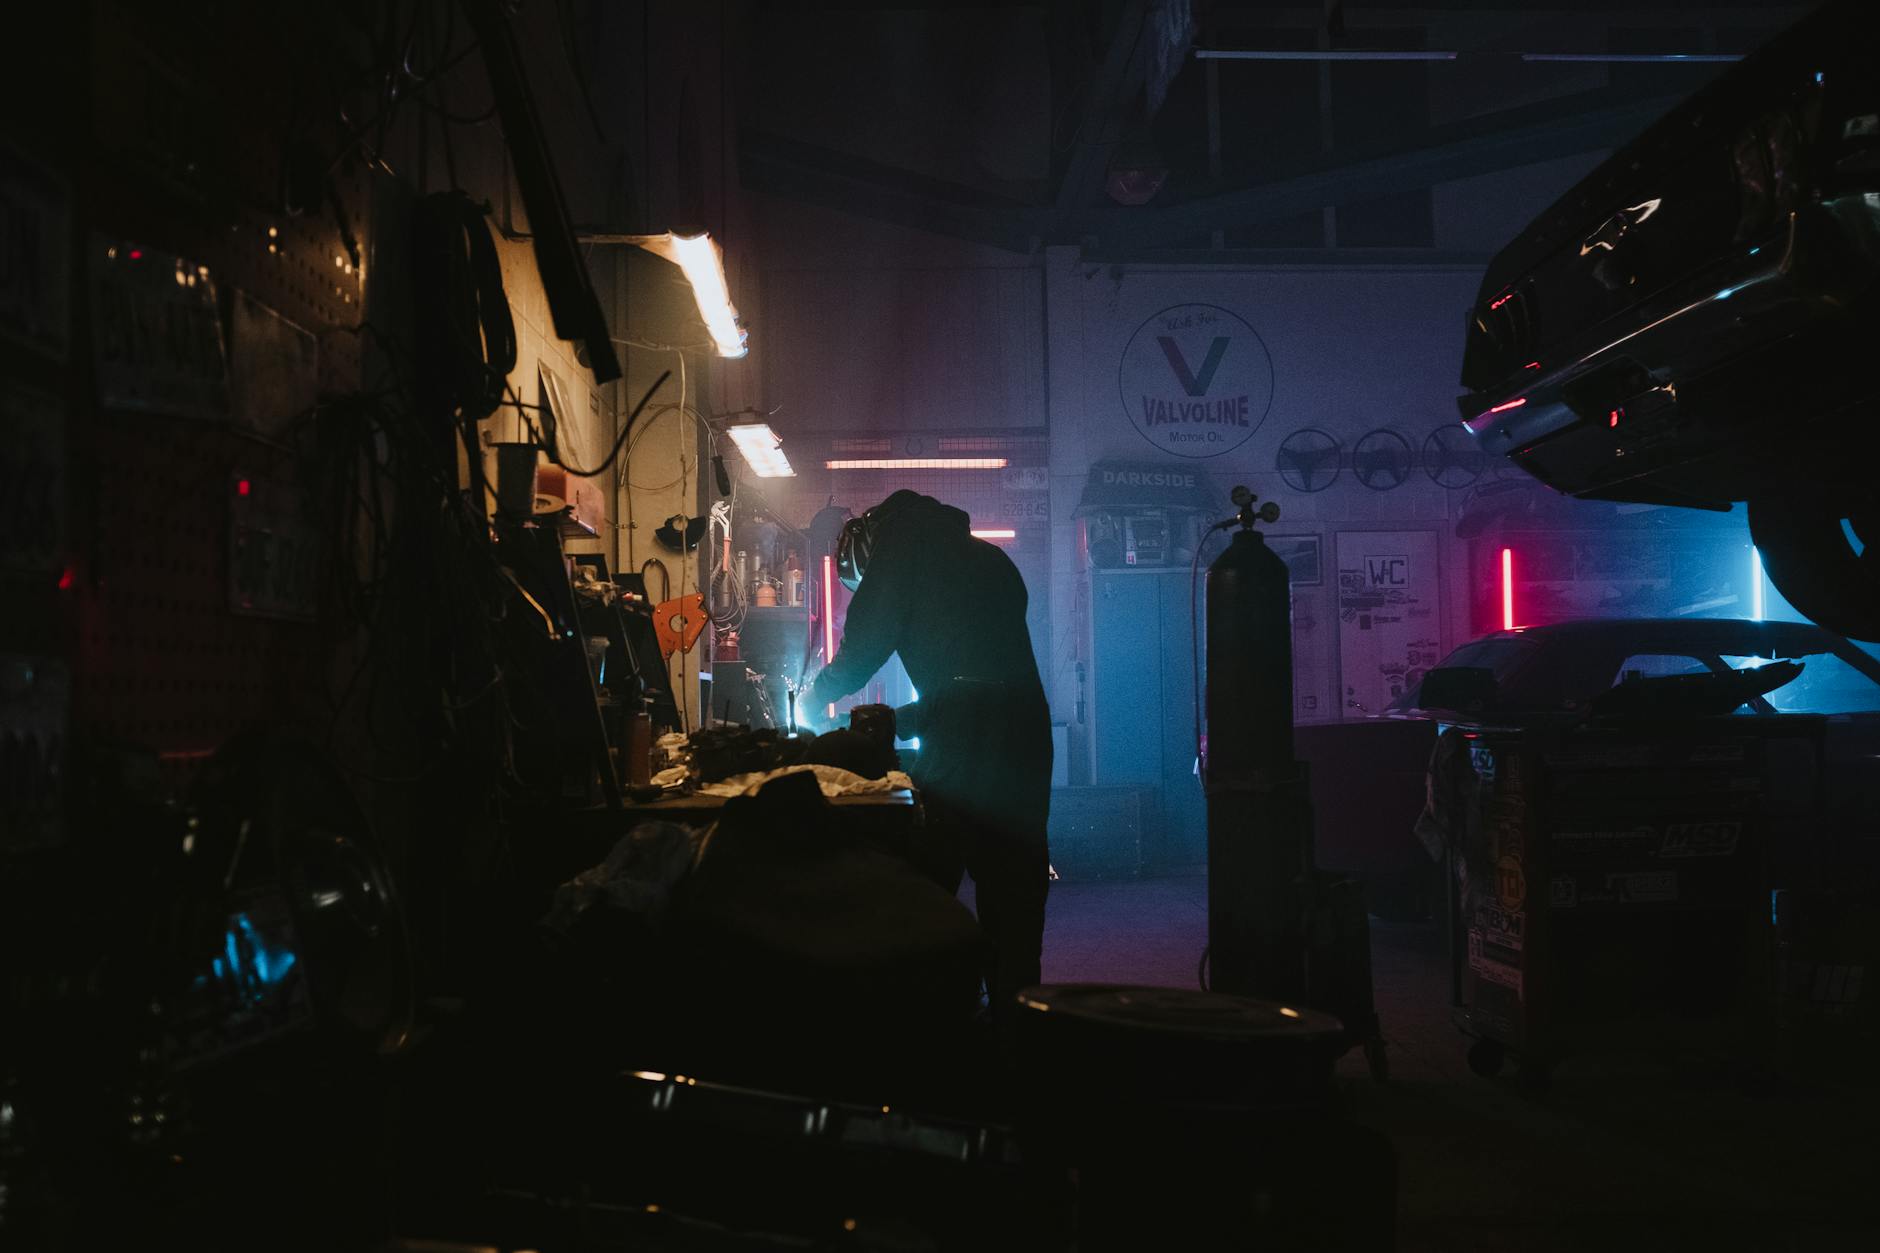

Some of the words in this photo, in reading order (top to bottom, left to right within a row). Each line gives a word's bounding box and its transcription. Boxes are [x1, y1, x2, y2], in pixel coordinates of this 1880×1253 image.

[1156, 336, 1232, 397] V
[1142, 395, 1250, 427] VALVOLINE
[1103, 470, 1196, 488] DARKSIDE
